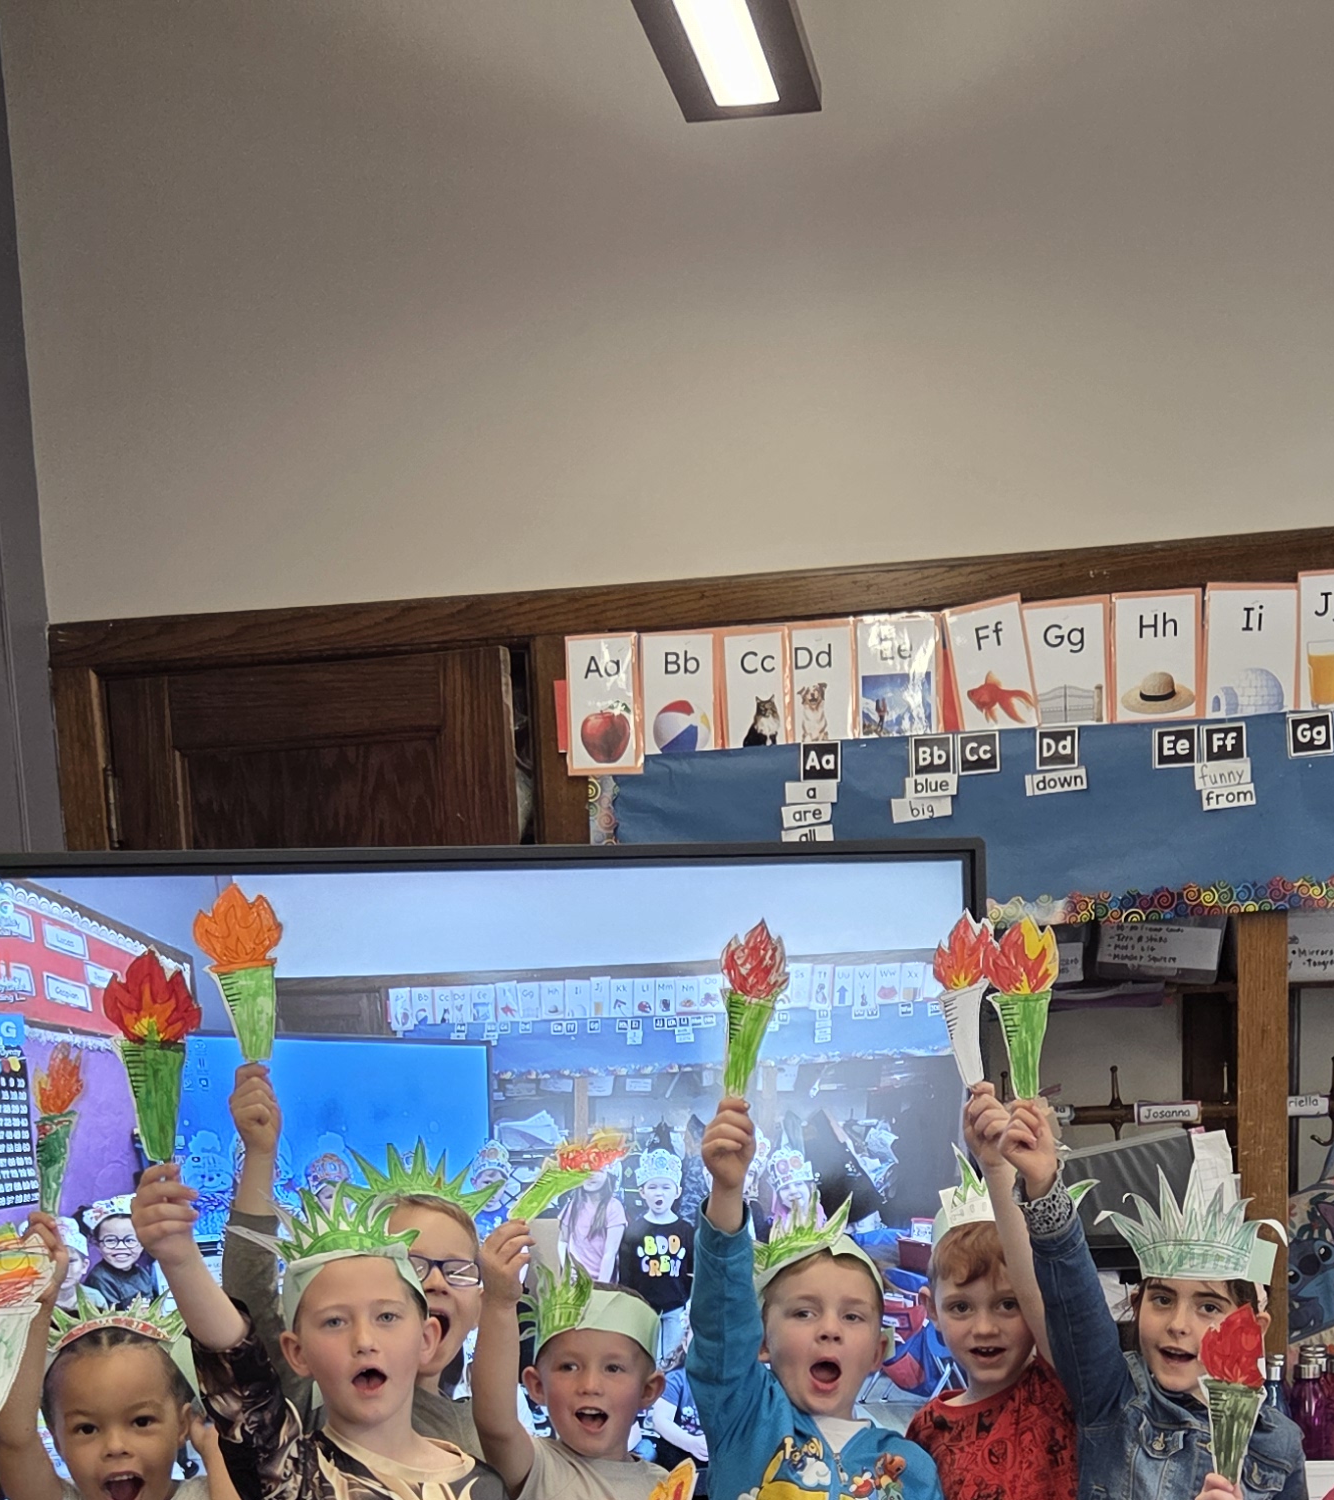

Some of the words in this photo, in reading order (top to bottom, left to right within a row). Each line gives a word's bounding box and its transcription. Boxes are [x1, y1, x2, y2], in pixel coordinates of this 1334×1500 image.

[1139, 614, 1178, 638] Hh
[1242, 606, 1264, 632] Ii
[975, 621, 1003, 651] Ff
[1043, 624, 1085, 653] Gg
[584, 655, 621, 679] Aa
[664, 652, 700, 675] Bb
[740, 651, 776, 674] Cc
[794, 644, 832, 671] Dd
[1043, 735, 1071, 757] Dd
[1212, 734, 1237, 752] Ff
[1297, 725, 1326, 746] Gg
[918, 746, 946, 766] Bb
[965, 742, 991, 761] Cc
[1162, 737, 1189, 756] Ee
[805, 750, 834, 771] Aa
[914, 777, 949, 794] blue
[1036, 770, 1083, 792] down
[1199, 764, 1244, 786] funny
[806, 786, 817, 799] a
[1205, 789, 1253, 806] from
[792, 806, 823, 824] are
[911, 801, 935, 818] big
[1288, 1096, 1319, 1107] riella
[1144, 1107, 1190, 1119] Josanna
